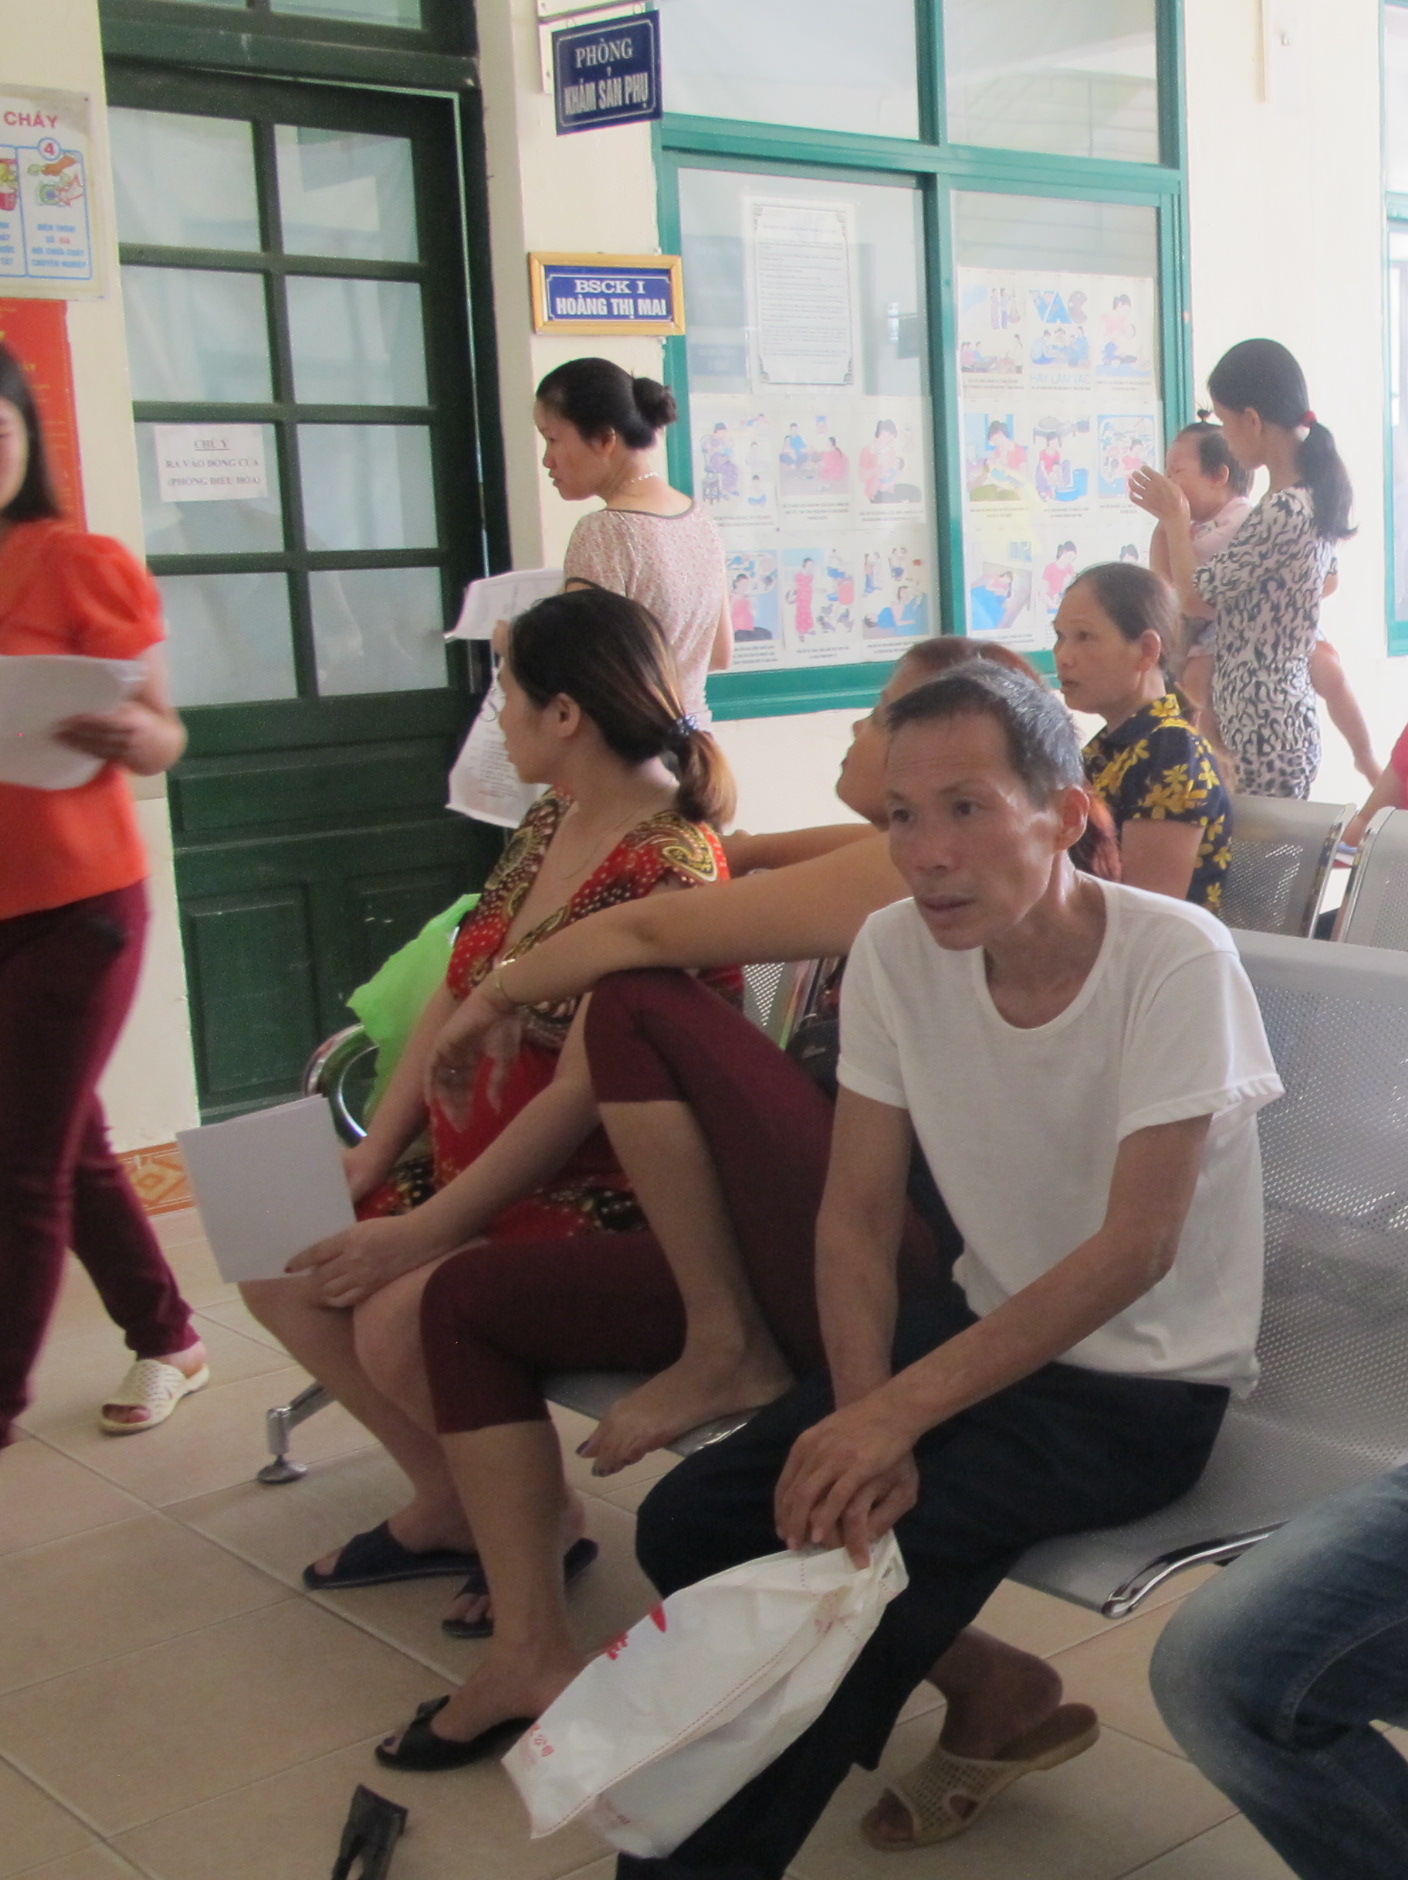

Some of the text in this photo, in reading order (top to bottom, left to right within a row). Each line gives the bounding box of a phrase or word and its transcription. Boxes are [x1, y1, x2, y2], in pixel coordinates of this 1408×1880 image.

[575, 38, 634, 69] PHÒNG
[624, 72, 649, 109] PHỤ
[44, 142, 55, 156] 4
[574, 279, 632, 294] BSCK
[556, 294, 667, 319] HOÀNG THỊ MAI
